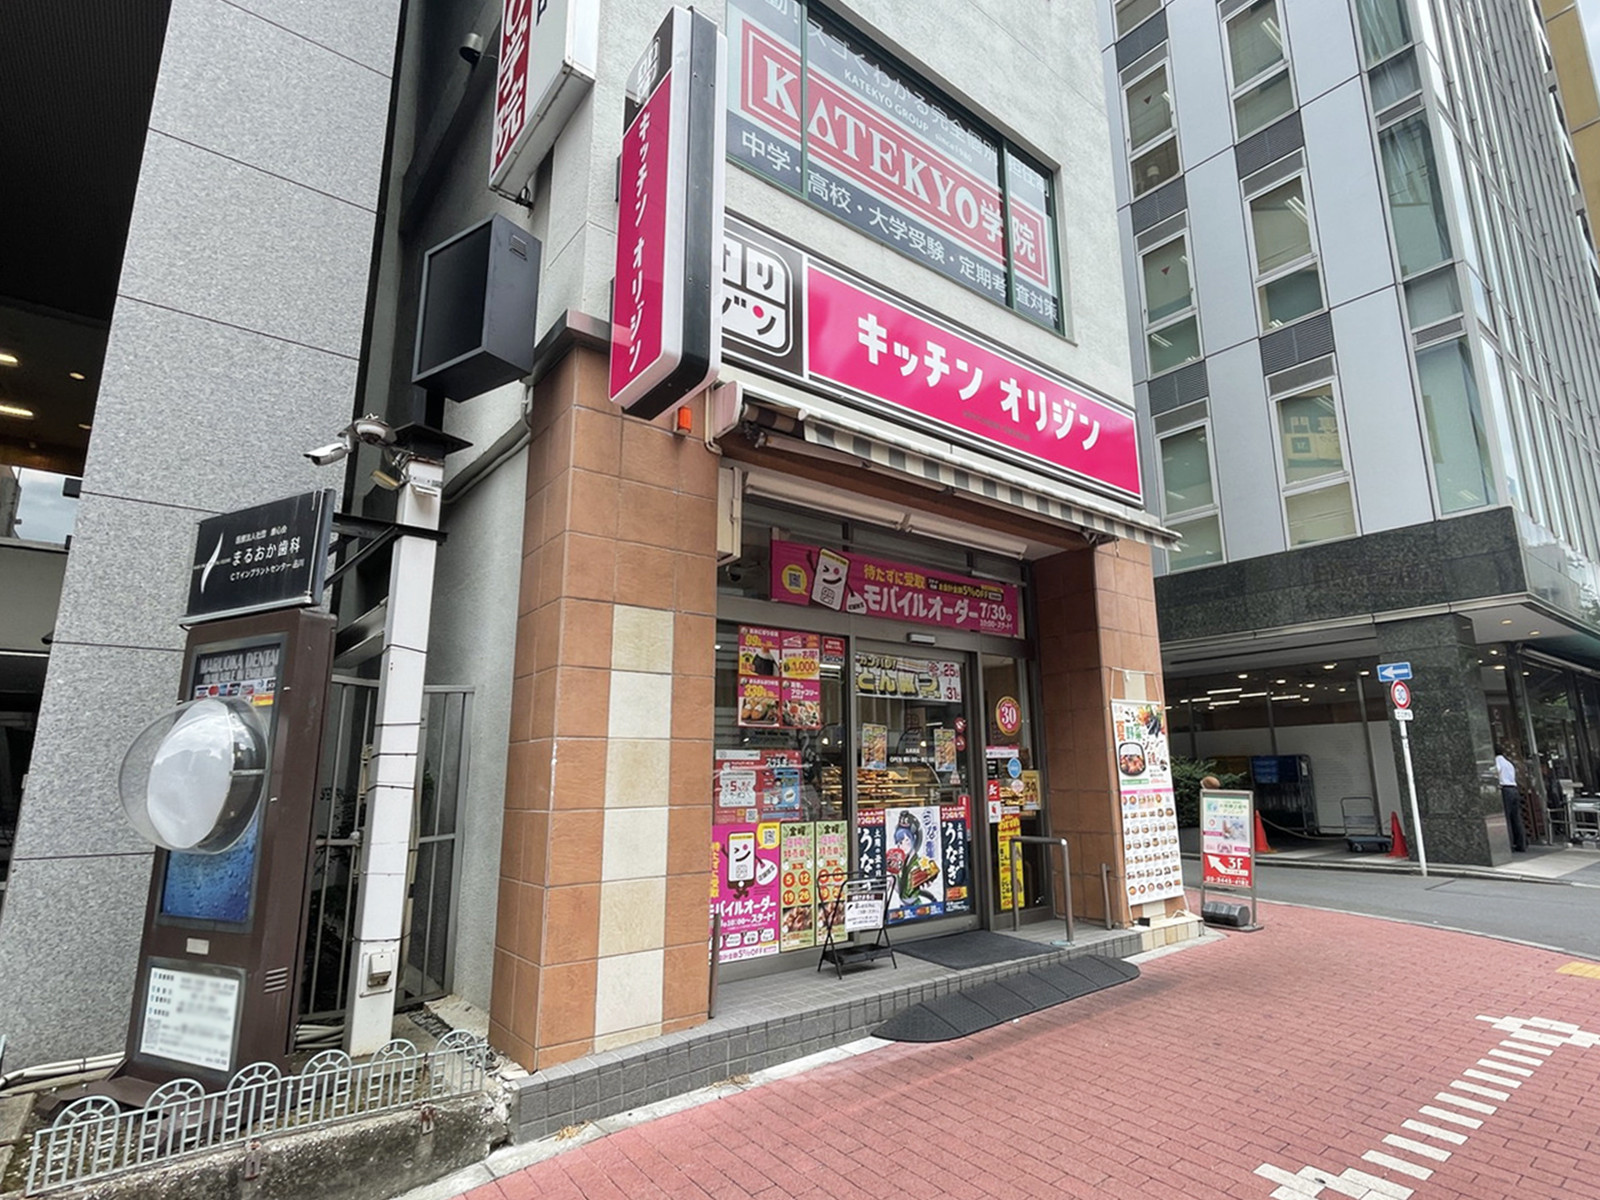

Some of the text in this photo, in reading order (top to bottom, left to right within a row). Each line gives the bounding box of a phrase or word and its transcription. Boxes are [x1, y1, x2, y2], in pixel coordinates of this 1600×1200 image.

[844, 69, 929, 133] KATEKYO GROUP
[631, 111, 652, 227] キッチン
[628, 236, 646, 374] オリジン
[857, 312, 1101, 452] キッチン オリジン
[232, 536, 301, 567] まるおか歯科
[864, 564, 925, 589] 待たずに受取
[864, 584, 979, 624] モバイルオーダー
[979, 602, 1006, 621] 7/30
[1001, 706, 1017, 724] 30
[945, 822, 960, 885] うなぎ
[1228, 857, 1243, 870] 3F
